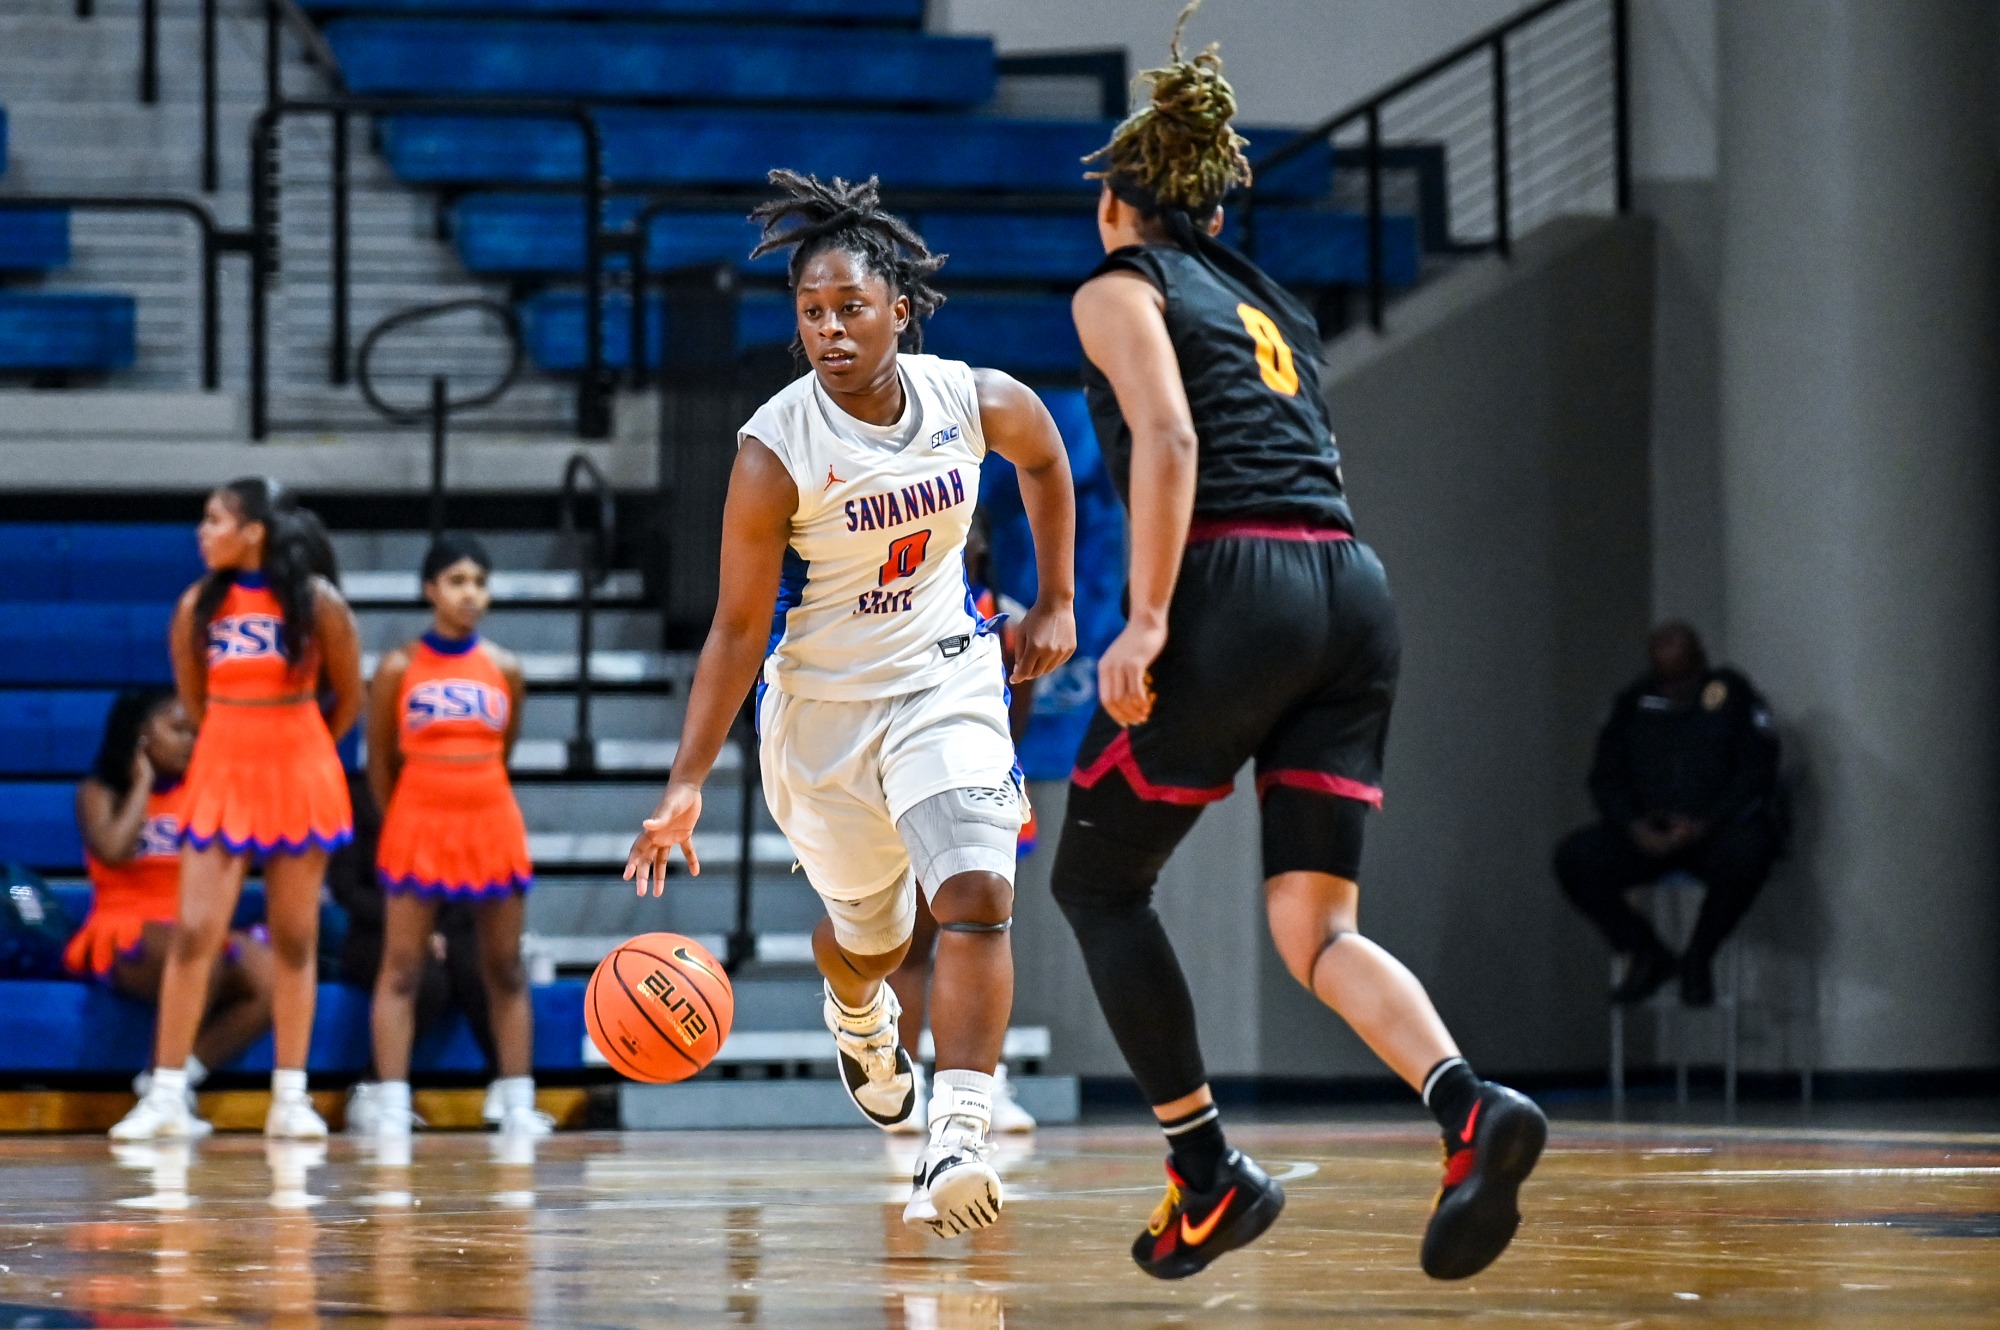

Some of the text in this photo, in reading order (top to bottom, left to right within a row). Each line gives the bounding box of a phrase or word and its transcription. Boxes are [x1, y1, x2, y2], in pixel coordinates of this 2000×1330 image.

[1237, 303, 1299, 396] 0
[932, 425, 958, 448] SIAC
[845, 468, 965, 532] SAVANNAH
[878, 528, 931, 588] 0
[207, 614, 289, 660] SS
[404, 680, 508, 731] SSU
[643, 969, 708, 1041] ELITE
